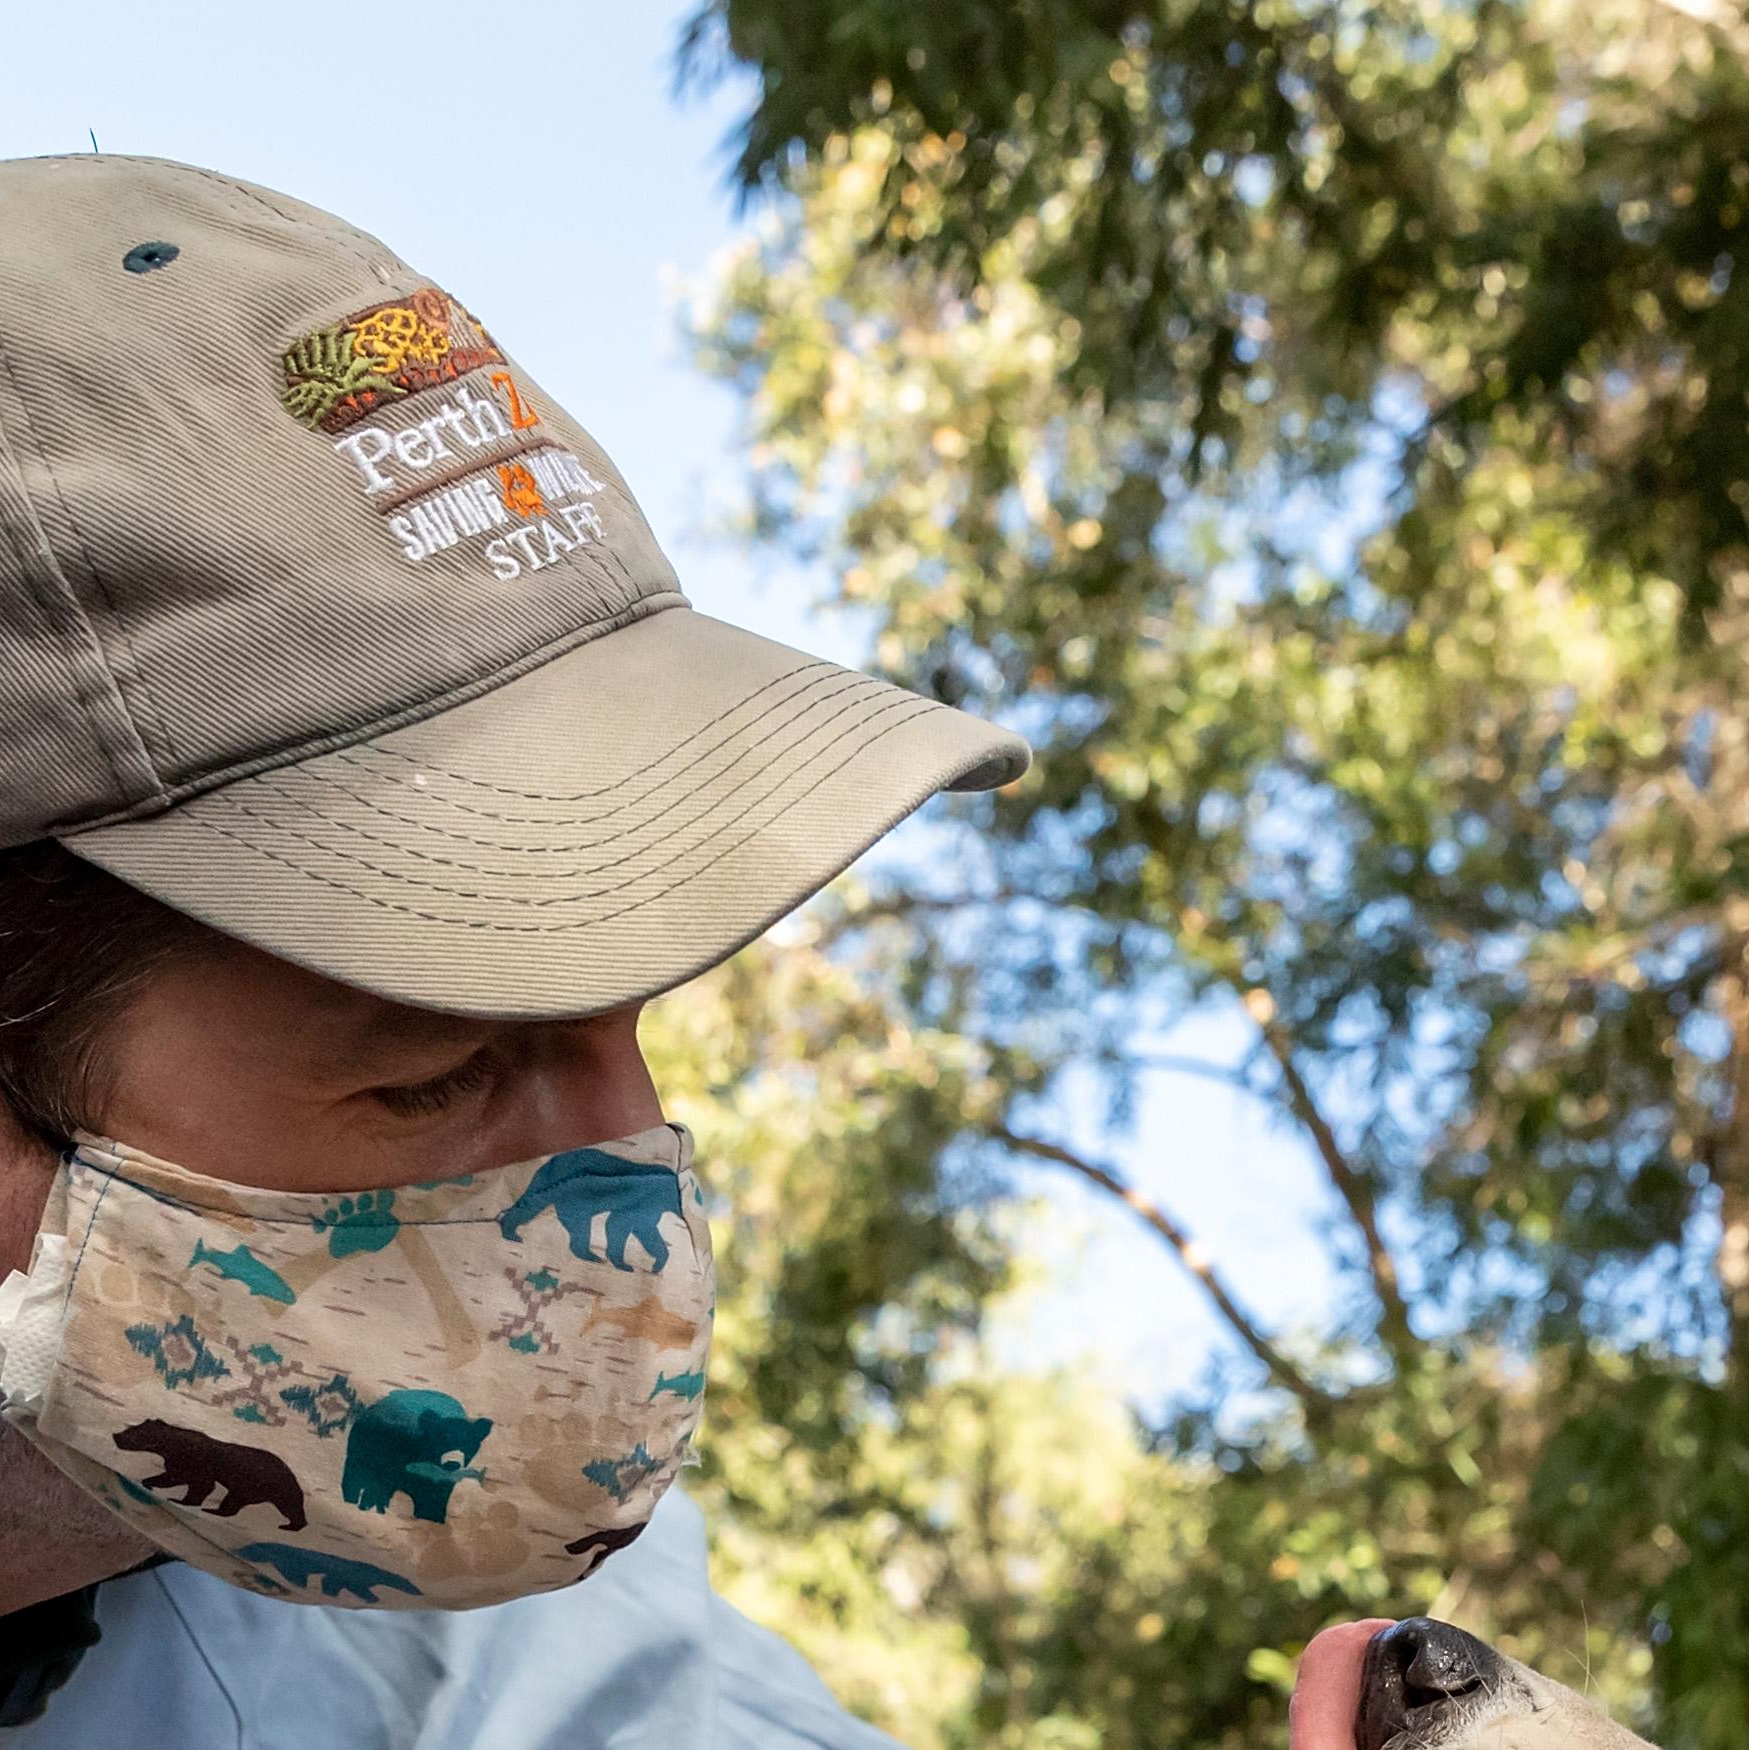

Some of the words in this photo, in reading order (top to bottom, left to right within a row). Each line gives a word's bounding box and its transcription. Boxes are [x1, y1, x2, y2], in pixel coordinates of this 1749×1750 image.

[333, 386, 513, 495] Perth
[388, 478, 509, 562] SAVING
[484, 501, 608, 582] STAFF
